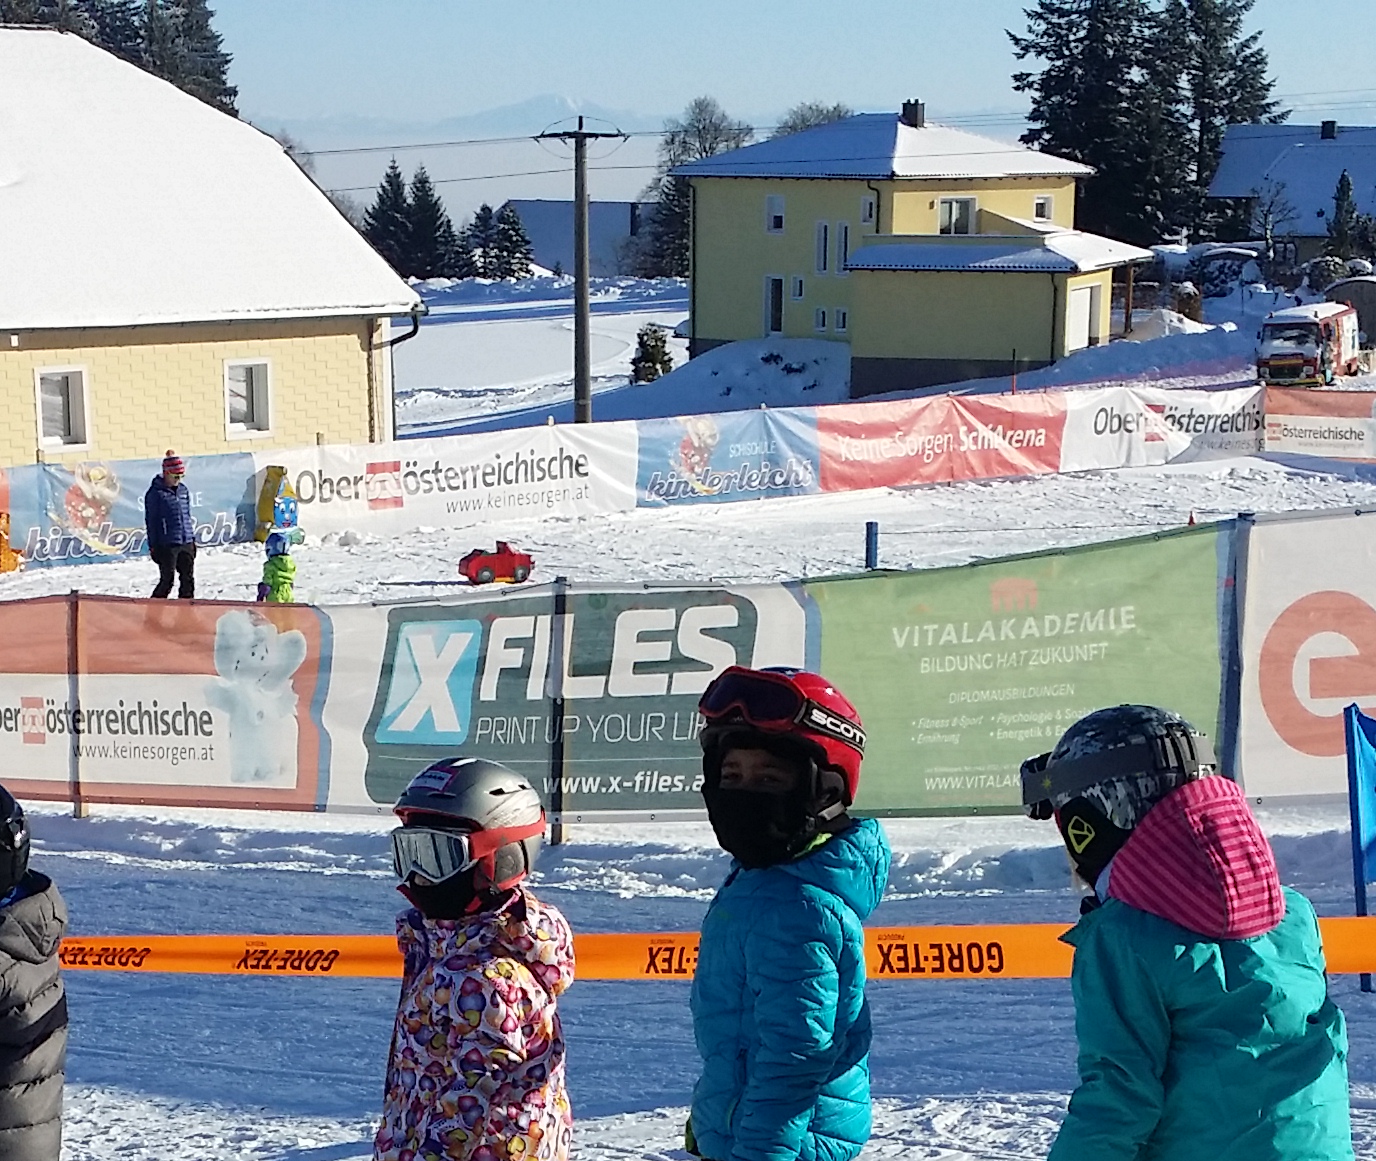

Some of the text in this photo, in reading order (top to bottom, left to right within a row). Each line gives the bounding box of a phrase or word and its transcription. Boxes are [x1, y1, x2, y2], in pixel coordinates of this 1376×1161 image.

[837, 433, 891, 461] Keine
[894, 430, 953, 463] Sorgen
[1282, 424, 1365, 441] österreichische
[296, 447, 589, 505] Ober österreichische
[646, 458, 812, 500] kinderleicht
[446, 486, 589, 514] www.keinesorgen.at
[892, 606, 1137, 648] VITALAKADEMIE
[921, 642, 1109, 673] BILDUNG HAT ZUKUNFT
[949, 684, 1075, 703] DIPLOMAUSBILDUNGEN
[46, 699, 213, 737] österreichische
[475, 715, 542, 744] PRINT
[543, 715, 582, 744] UP
[585, 713, 665, 742] YOUR
[73, 740, 214, 765] www.keinesorgen.at
[543, 770, 705, 794] www.x-files.a
[925, 775, 1021, 790] WWW.VITALAK
[236, 949, 340, 972] GORE-TEX
[878, 940, 1005, 975] GORE-TEX
